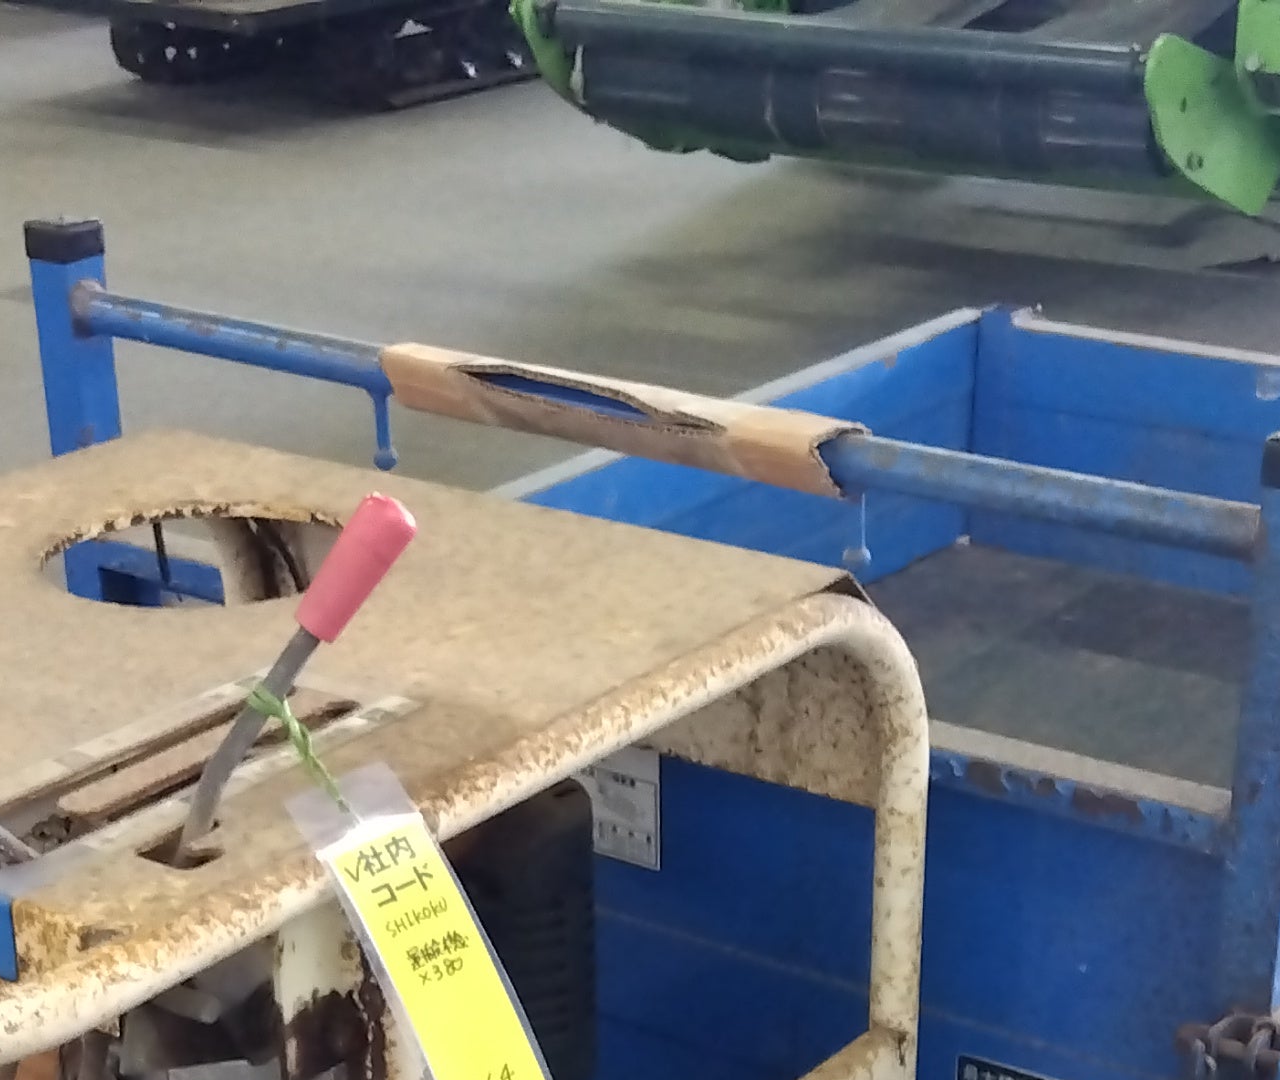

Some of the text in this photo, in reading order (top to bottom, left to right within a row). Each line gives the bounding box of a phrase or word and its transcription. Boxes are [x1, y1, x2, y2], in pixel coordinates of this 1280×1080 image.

[371, 863, 433, 908] コード
[386, 896, 448, 938] SHIKOKU
